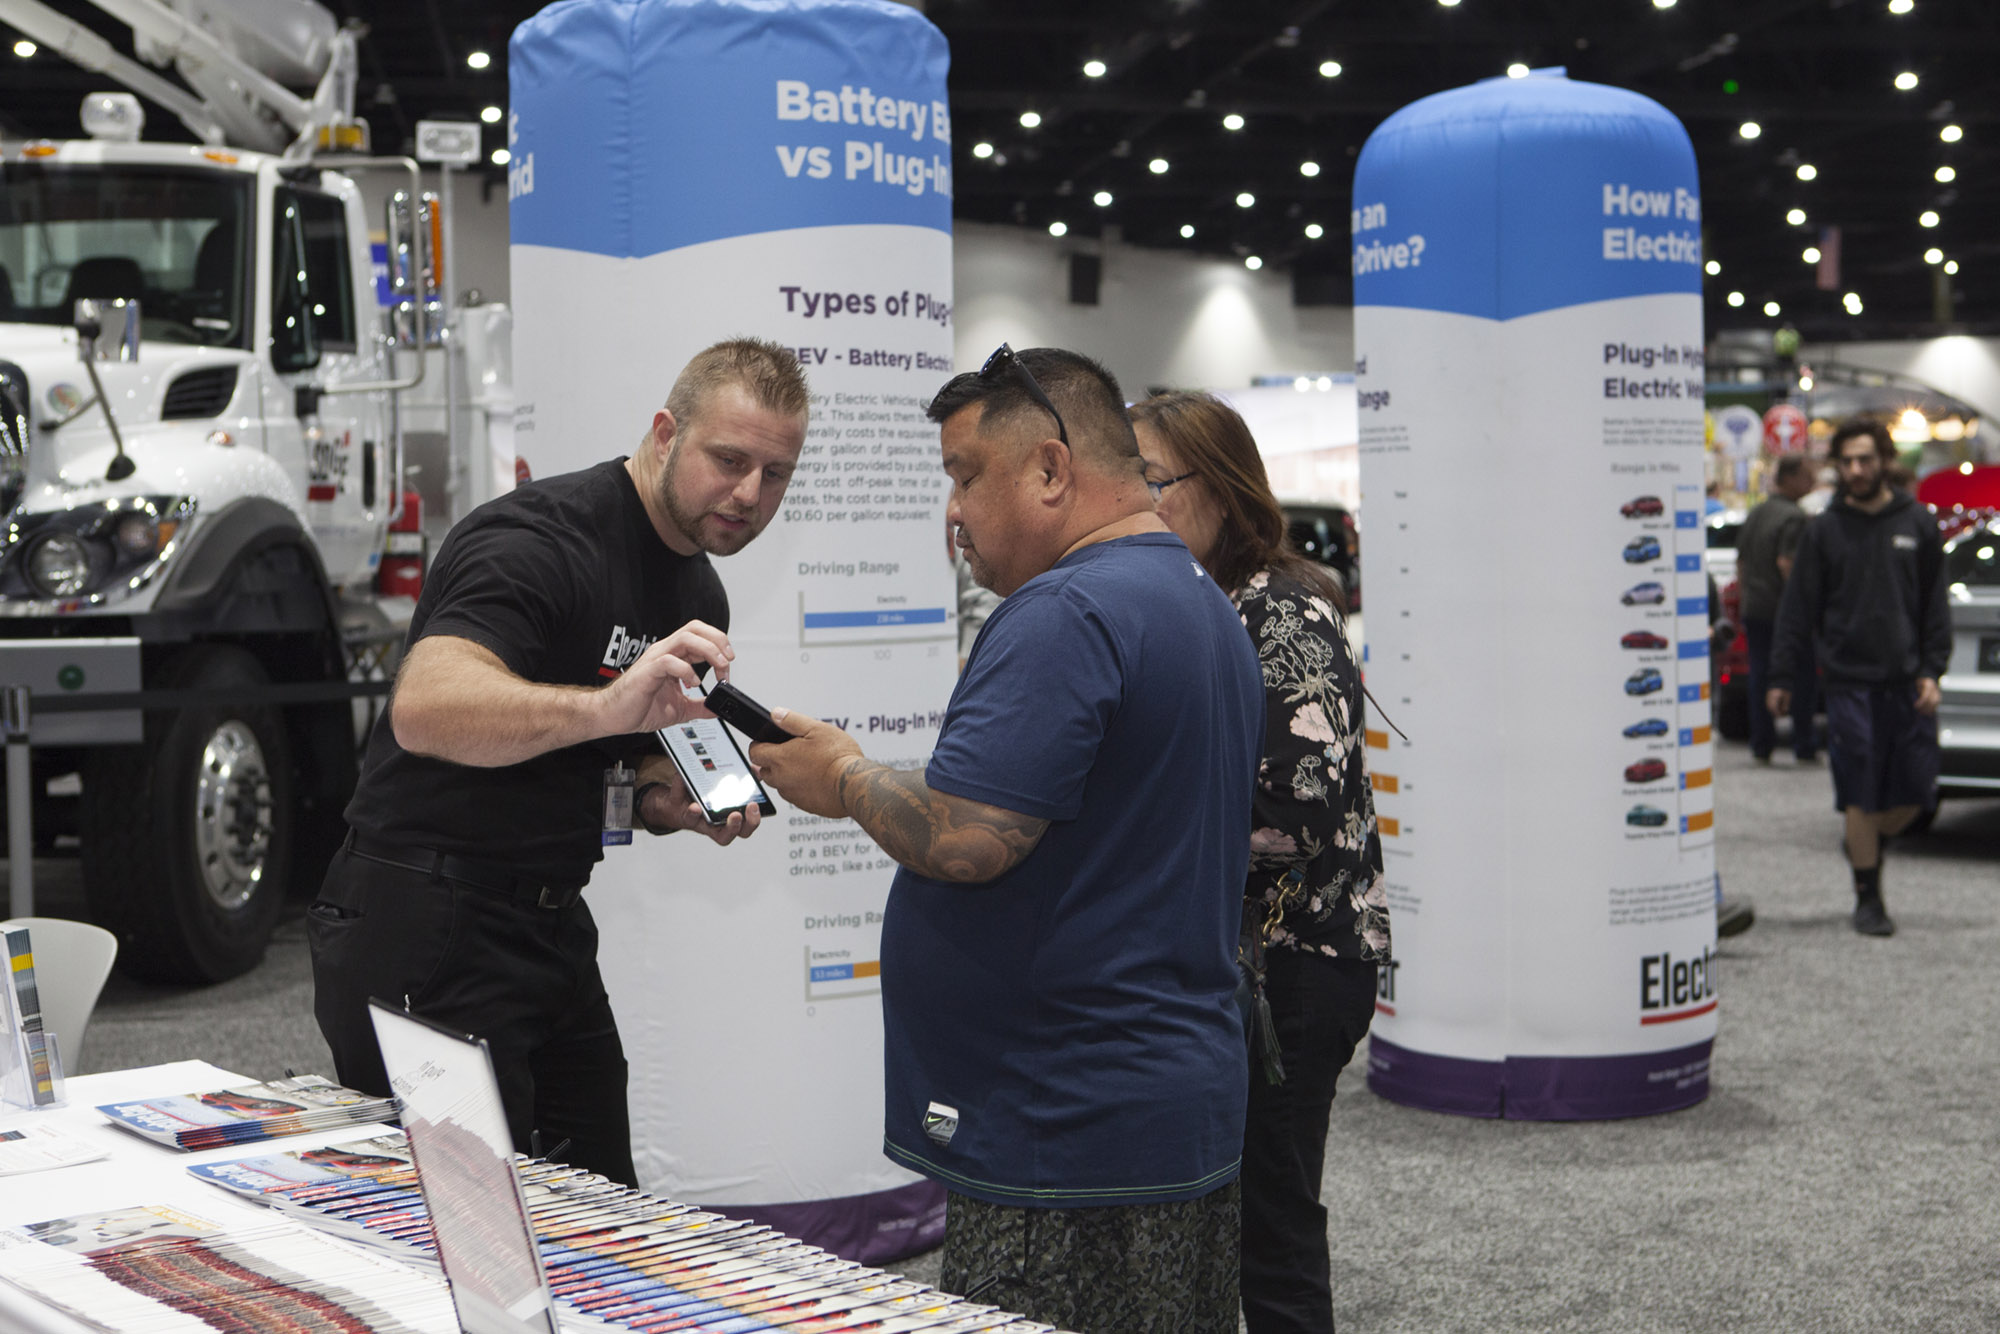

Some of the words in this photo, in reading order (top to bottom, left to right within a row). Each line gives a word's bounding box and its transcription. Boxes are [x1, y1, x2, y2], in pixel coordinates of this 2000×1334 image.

[776, 80, 927, 142] Battery
[776, 145, 832, 179] vs
[1603, 183, 1671, 218] How
[779, 286, 877, 319] Types
[885, 289, 909, 317] of
[849, 348, 912, 371] Battery
[1604, 342, 1679, 369] Plug-In
[1604, 376, 1681, 399] Electric
[834, 392, 878, 405] Electric
[831, 408, 855, 421] This
[845, 428, 876, 438] costs
[802, 444, 824, 456] per
[830, 443, 867, 456] gallon
[814, 476, 840, 488] cost
[823, 493, 843, 504] the
[847, 493, 871, 504] cost
[784, 508, 823, 522] $0.60
[827, 511, 847, 522] per
[798, 561, 855, 576] Driving
[859, 561, 900, 576] Range
[602, 624, 658, 668] Elect
[869, 712, 925, 734] Plug-In
[789, 848, 803, 860] of
[823, 845, 849, 857] BEV
[855, 843, 871, 855] for
[842, 860, 862, 872] like
[804, 913, 860, 930] Driving
